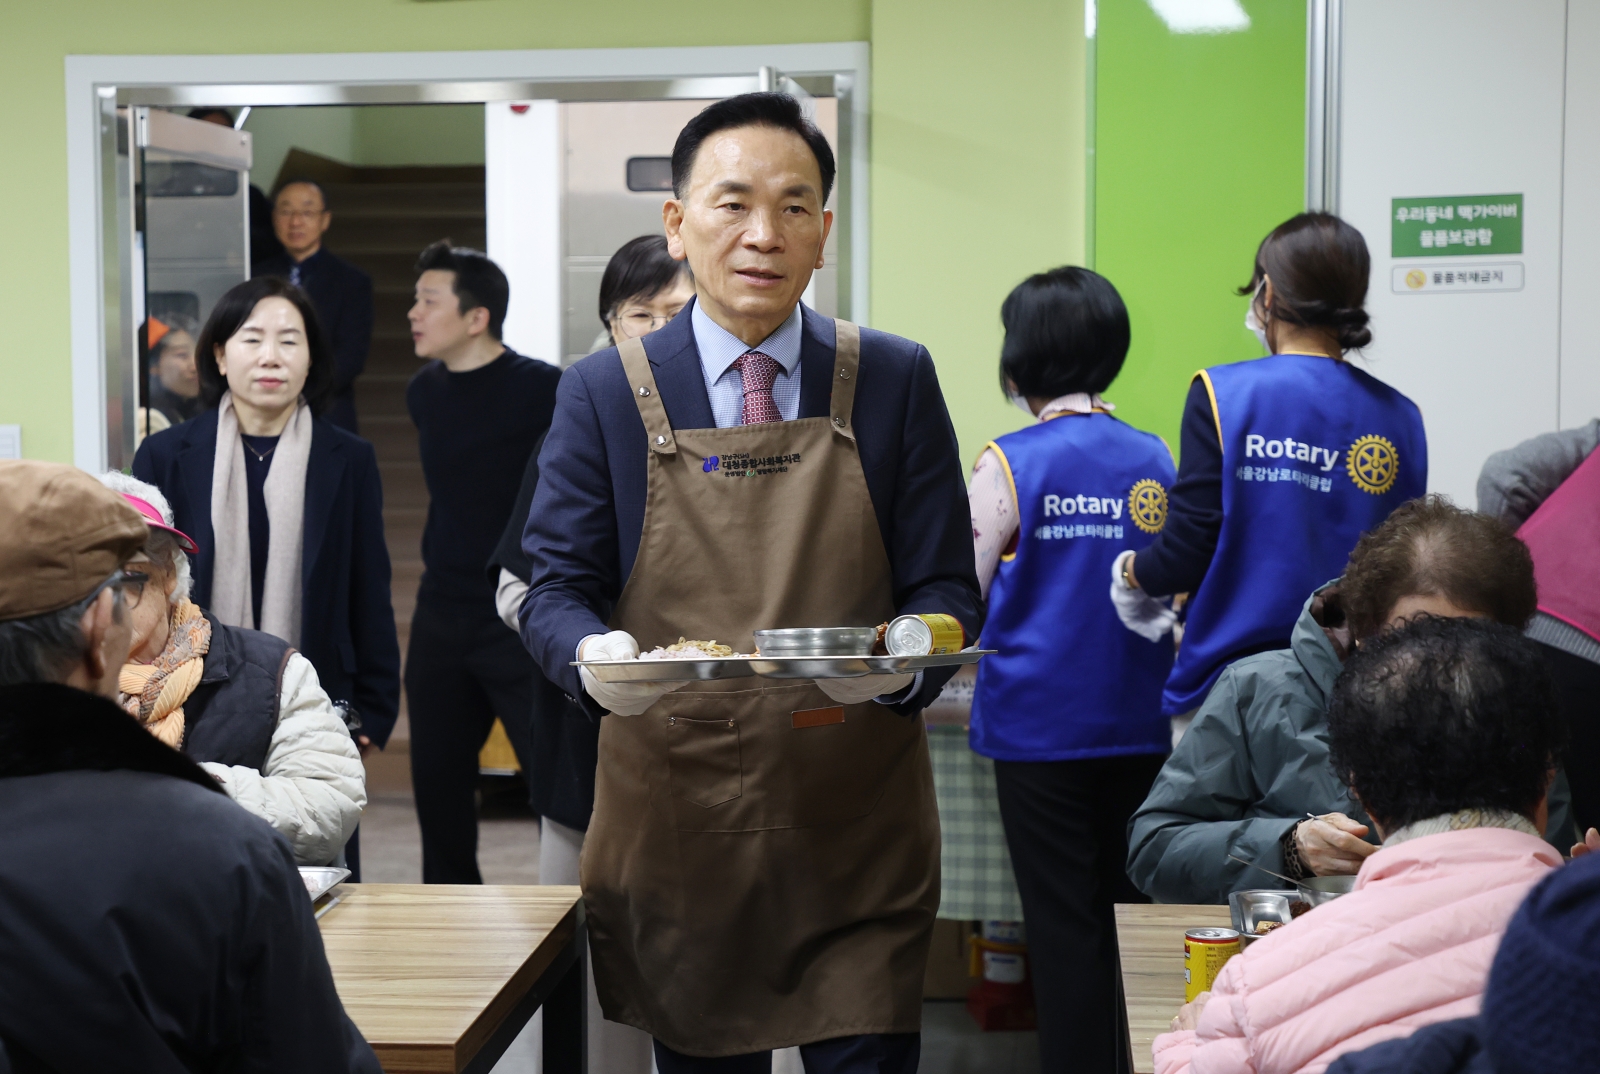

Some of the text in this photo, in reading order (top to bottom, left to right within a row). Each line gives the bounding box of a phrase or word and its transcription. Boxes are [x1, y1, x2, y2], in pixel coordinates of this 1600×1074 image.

[1396, 205, 1454, 224] 우리동네
[1245, 434, 1339, 472] Rotary
[1044, 494, 1123, 520] Rotary
